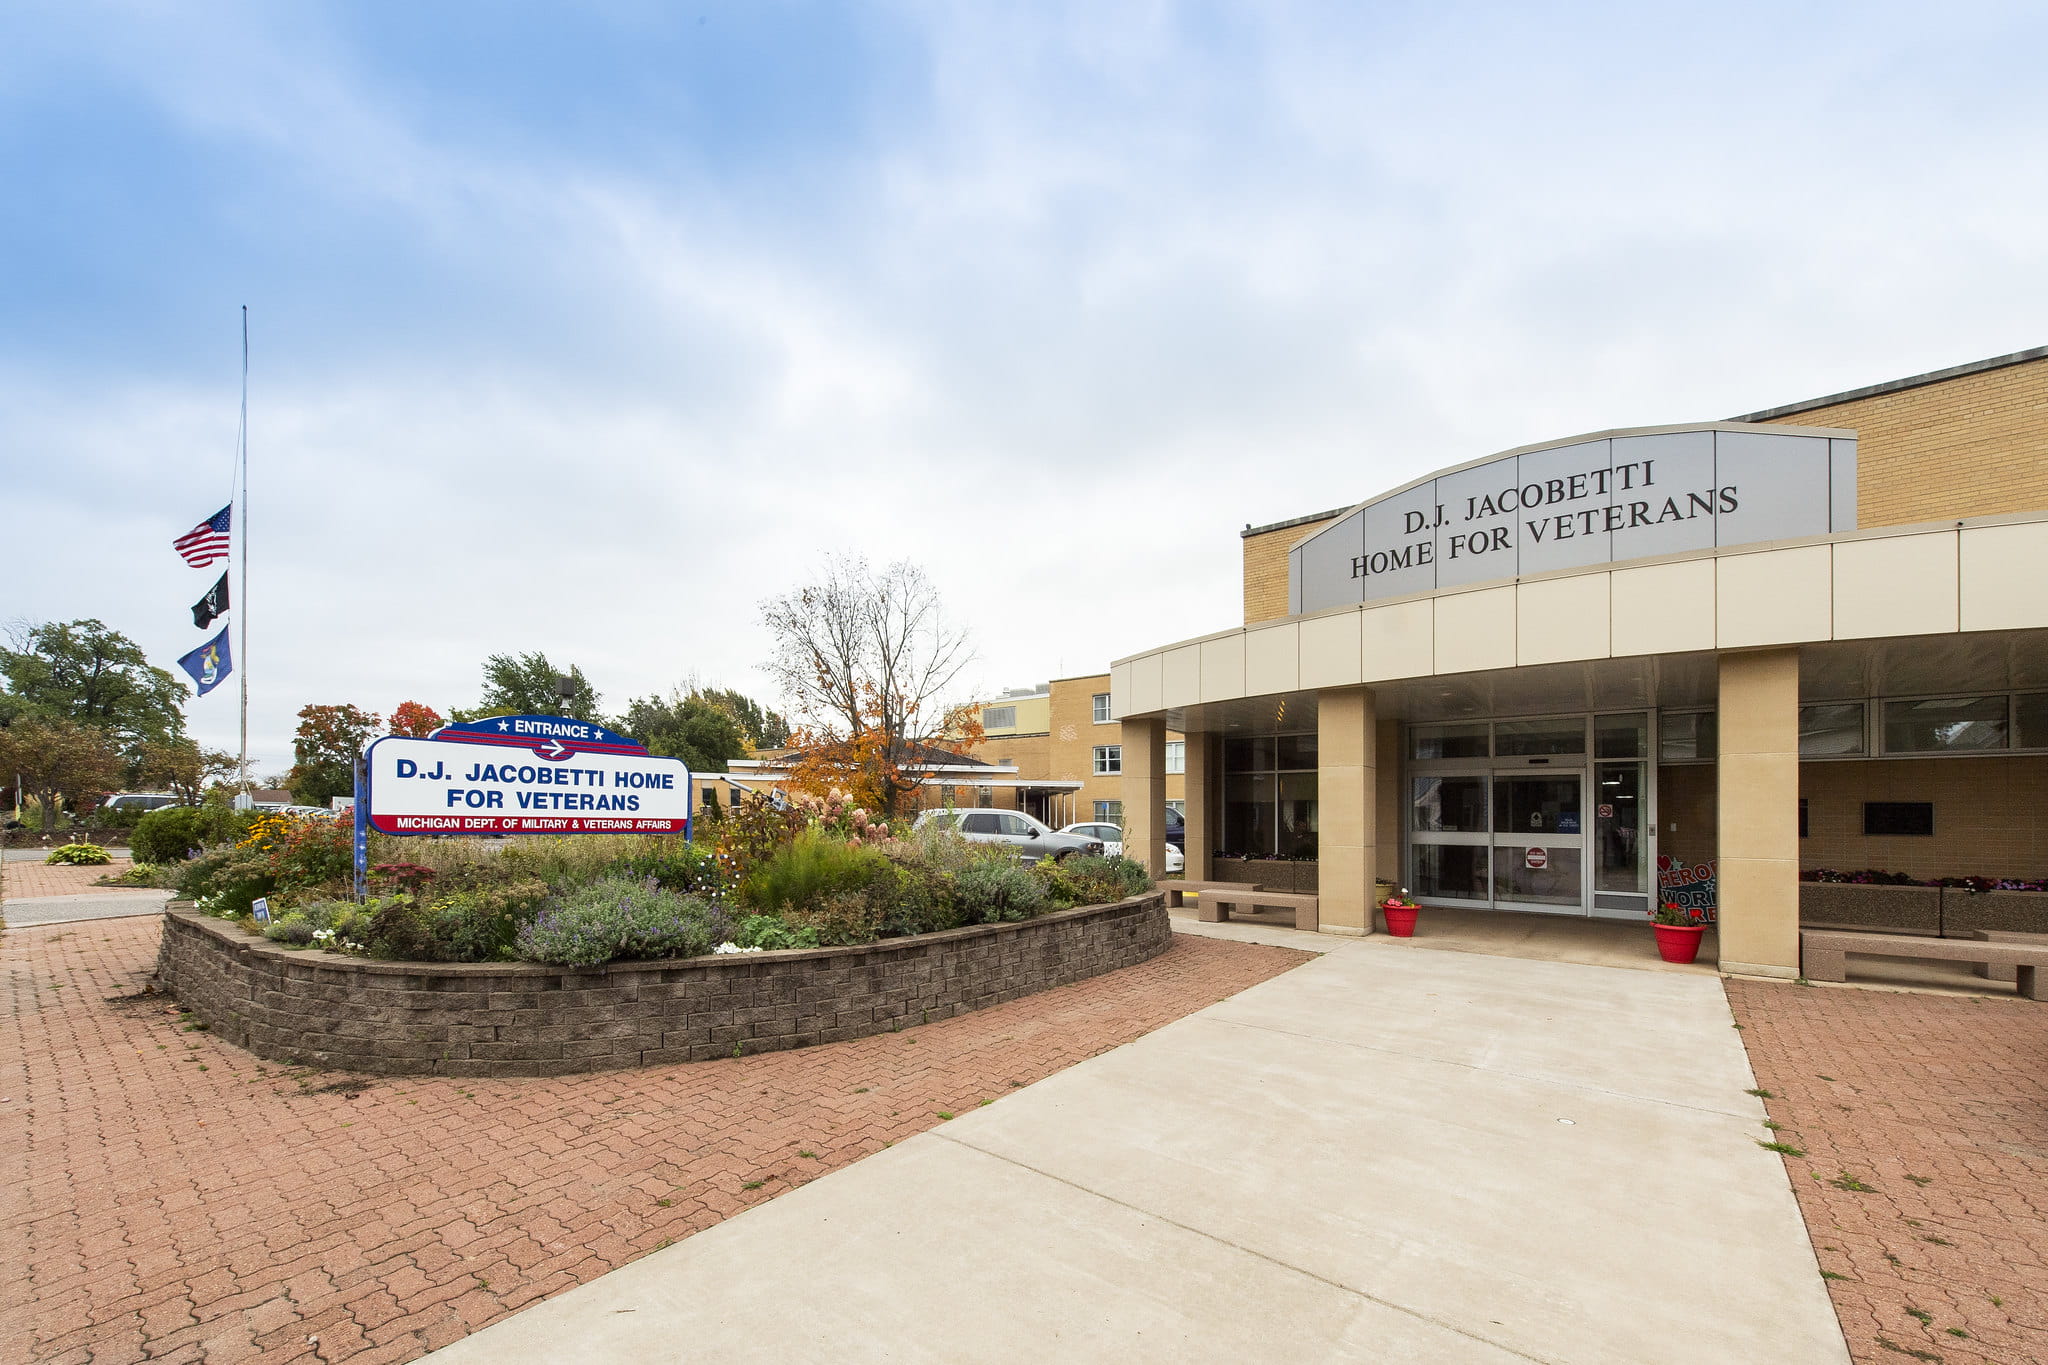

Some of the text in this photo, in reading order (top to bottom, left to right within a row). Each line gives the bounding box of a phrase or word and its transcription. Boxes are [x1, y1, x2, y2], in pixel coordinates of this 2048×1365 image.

[1404, 459, 1655, 534] D.J. JACOBETTI
[1351, 486, 1738, 579] HOME FOR VETERANS
[515, 720, 589, 739] ENTRANCE
[396, 758, 674, 789] D.J. JACOBETTI HOME
[447, 789, 640, 811] FOR VETERANS
[397, 817, 672, 830] MICHIGAN DEPT. OF MILITARY & VETERANS AFFAIRS
